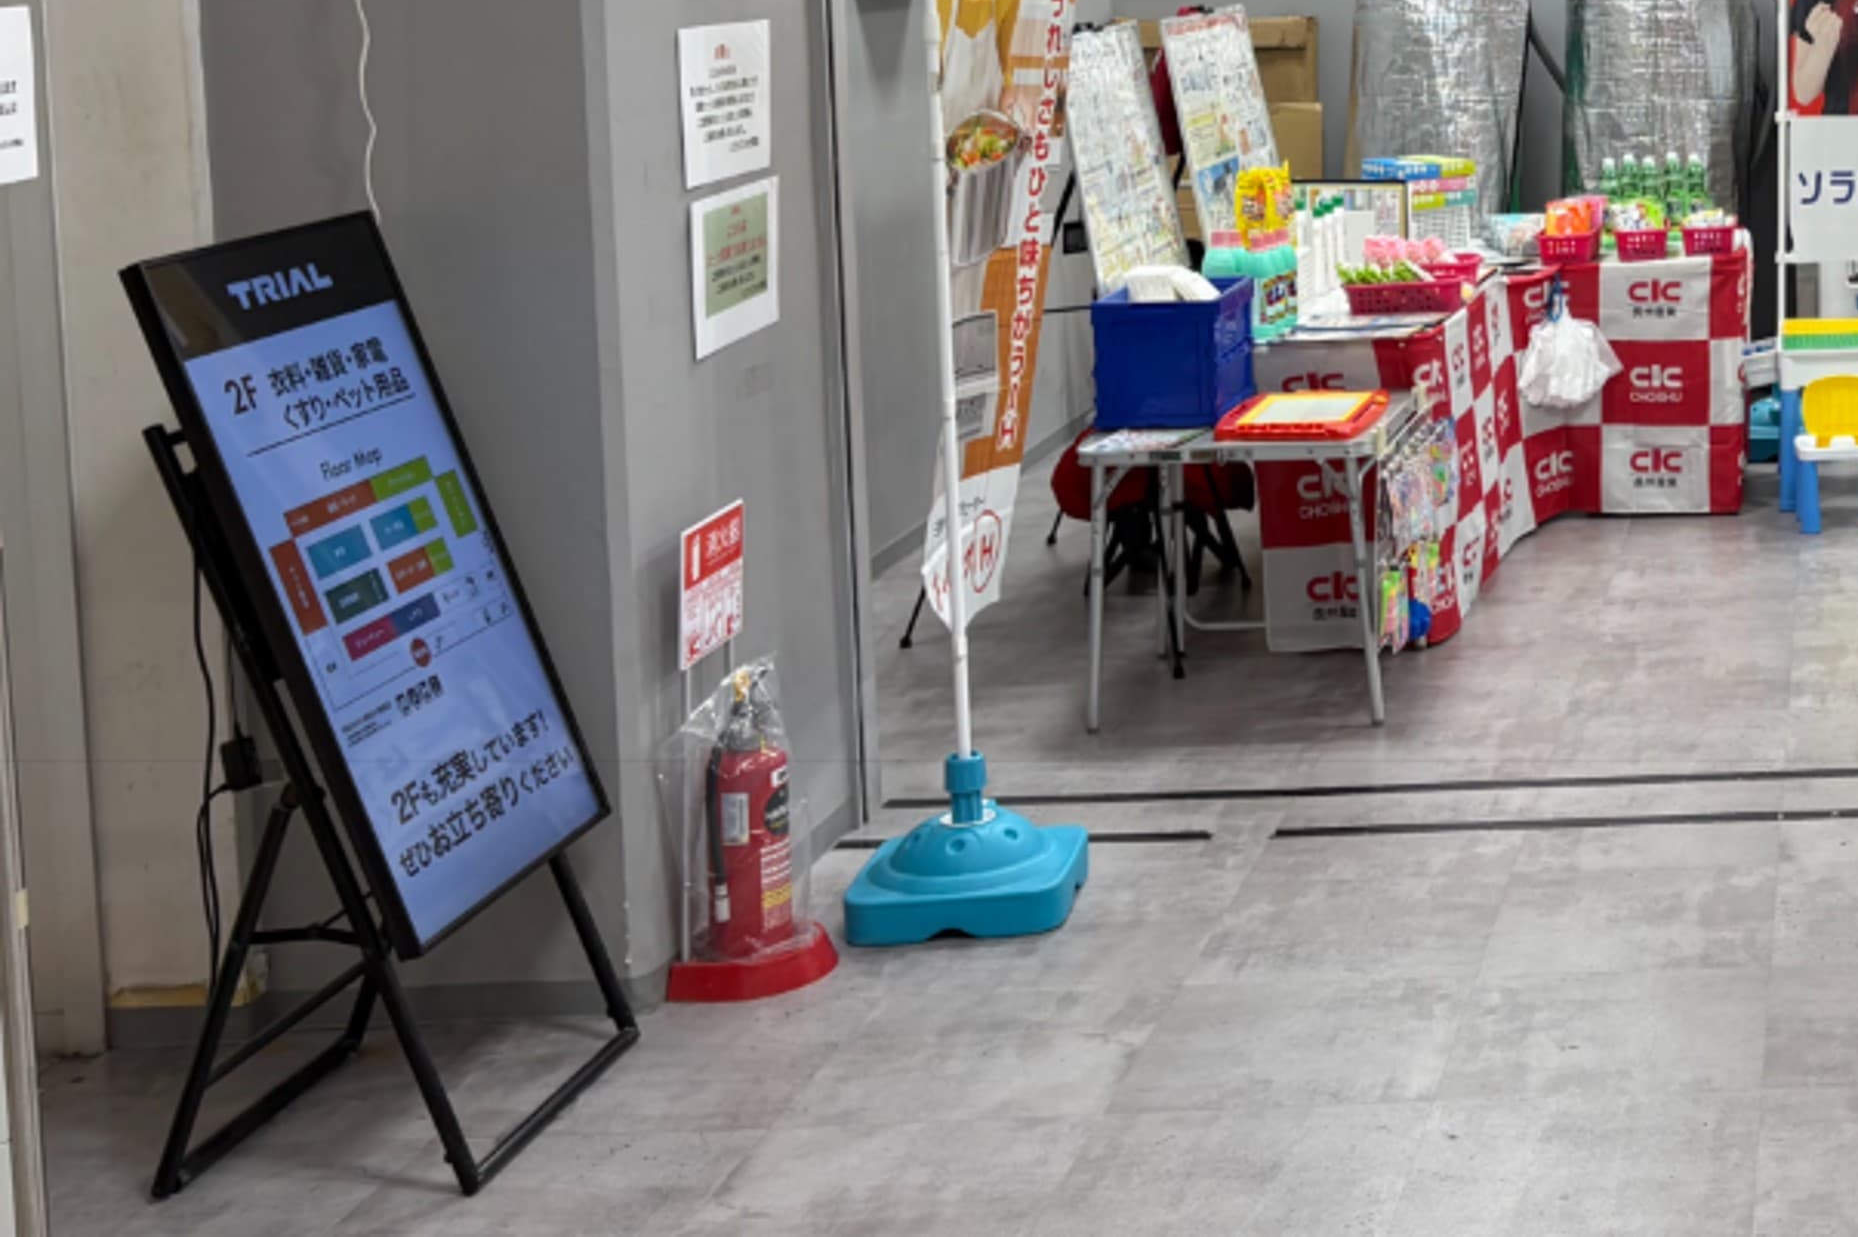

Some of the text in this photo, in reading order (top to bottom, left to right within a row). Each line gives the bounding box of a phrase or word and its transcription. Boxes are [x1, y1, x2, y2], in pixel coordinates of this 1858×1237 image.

[227, 262, 334, 311] TRIAL
[224, 374, 258, 416] 2F
[283, 366, 411, 430] くすり・ペット用品
[390, 709, 550, 826] 2Fも充実しています!
[398, 745, 576, 878] ぜひお立ち寄りください
